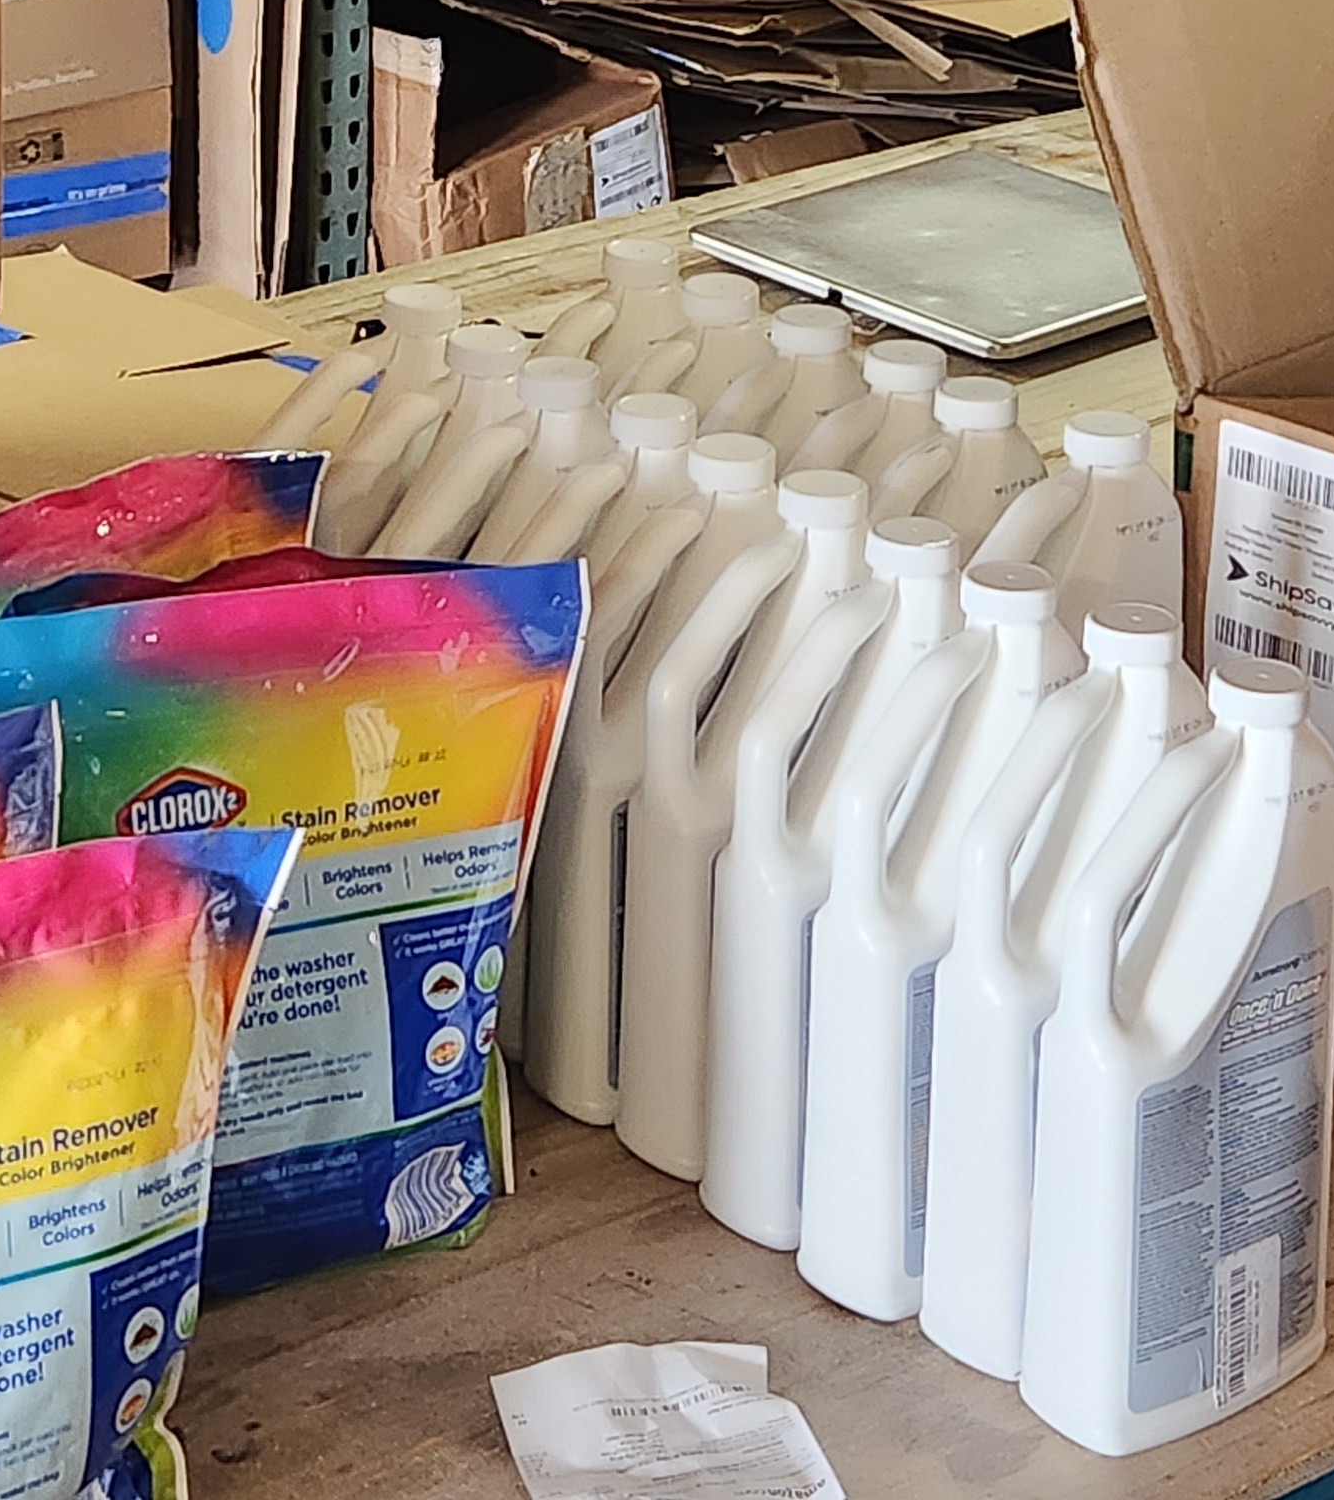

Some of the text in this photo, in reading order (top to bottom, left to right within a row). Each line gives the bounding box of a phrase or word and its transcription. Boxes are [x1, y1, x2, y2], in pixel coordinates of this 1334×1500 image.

[344, 786, 442, 818] Remover
[422, 848, 465, 869] Helps
[321, 861, 393, 887] Brightens
[335, 879, 384, 902] Colors
[283, 950, 356, 979] washer
[270, 968, 369, 1003] detergent
[283, 995, 341, 1023] done!
[51, 1106, 160, 1152] Remover
[50, 1140, 136, 1179] Brightener
[27, 1197, 109, 1232] Brightens
[40, 1222, 97, 1249] Colors
